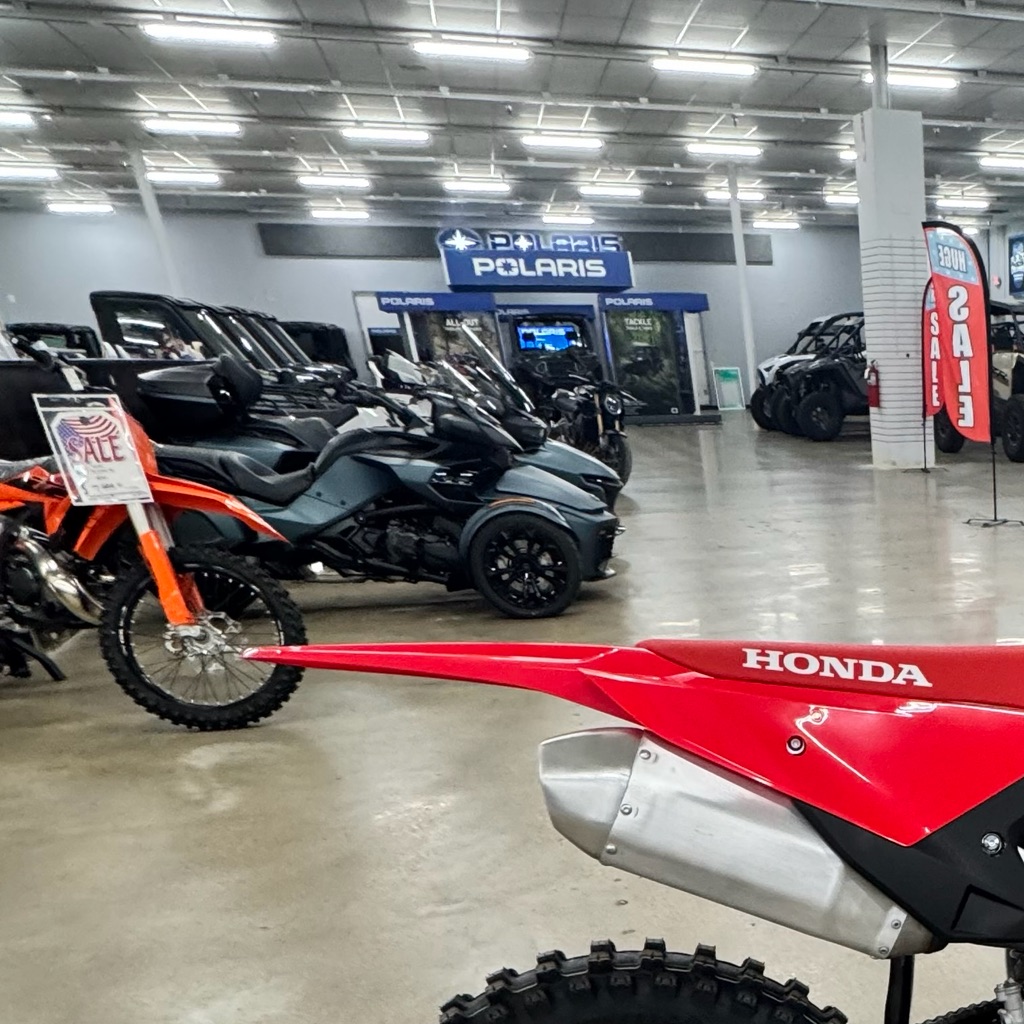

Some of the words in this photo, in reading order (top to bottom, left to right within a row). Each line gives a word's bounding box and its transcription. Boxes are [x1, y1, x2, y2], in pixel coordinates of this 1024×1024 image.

[471, 257, 607, 278] POLARIS
[380, 297, 435, 306] POLARIS
[605, 297, 654, 306] POLARIS
[624, 317, 652, 326] TACKLE
[929, 311, 941, 407] SALE
[67, 435, 125, 464] SALE
[742, 647, 933, 688] HONDA
